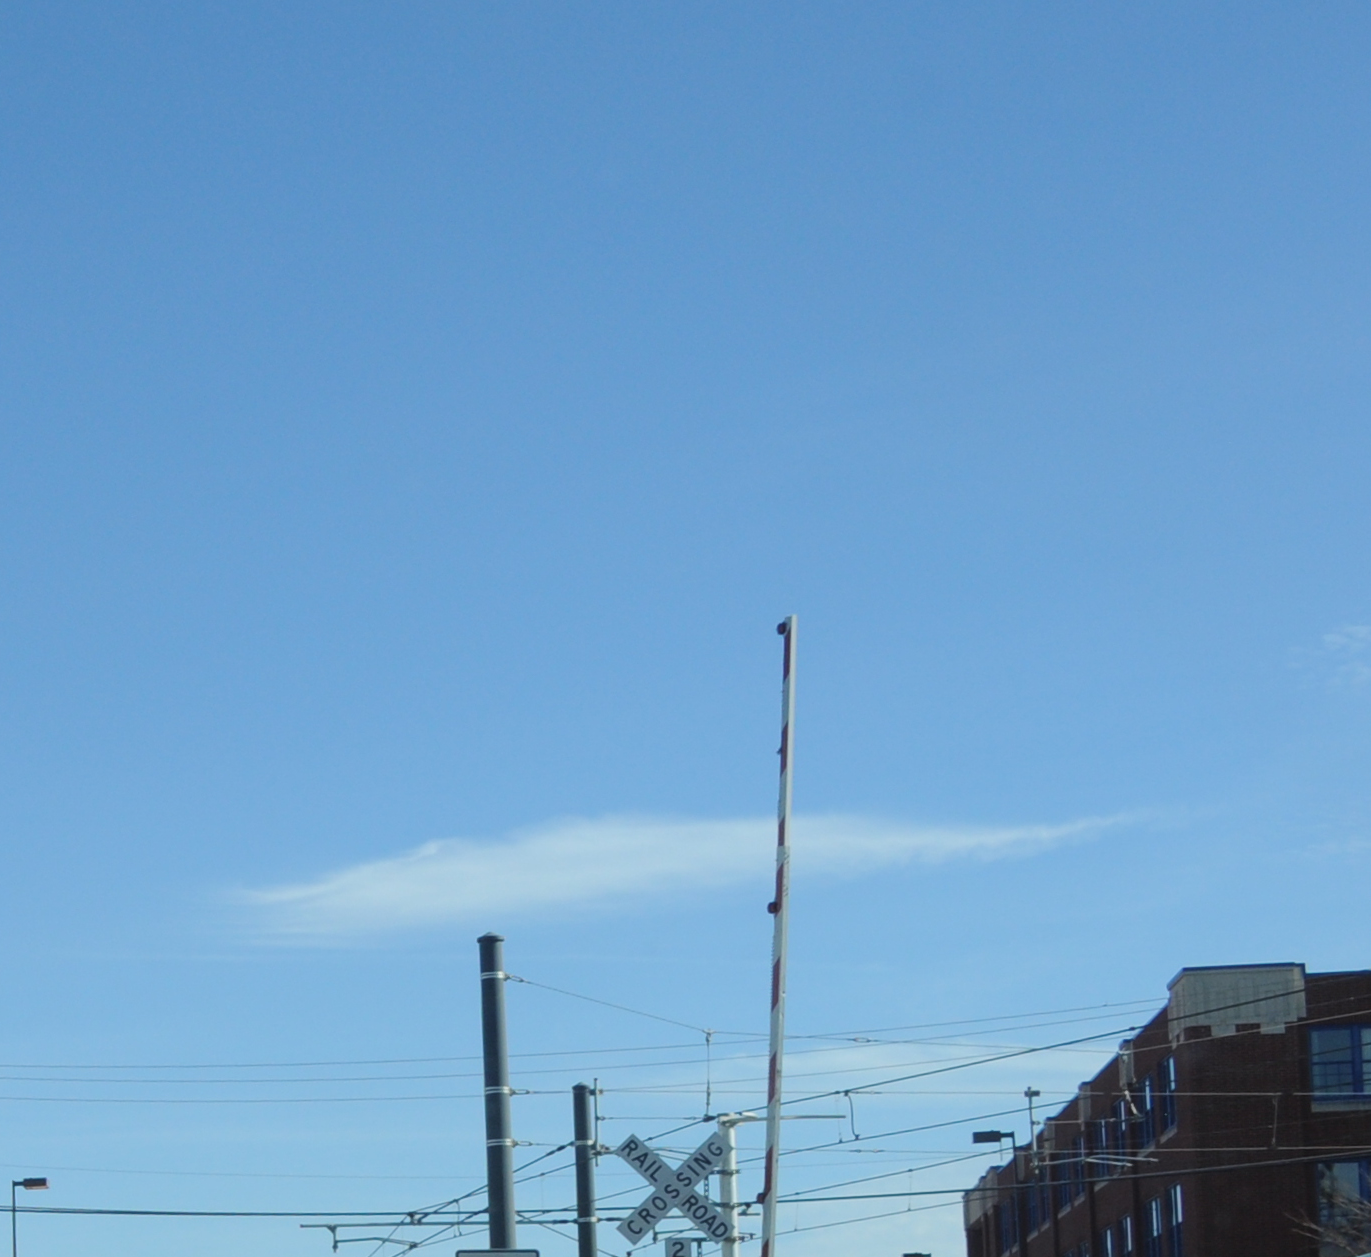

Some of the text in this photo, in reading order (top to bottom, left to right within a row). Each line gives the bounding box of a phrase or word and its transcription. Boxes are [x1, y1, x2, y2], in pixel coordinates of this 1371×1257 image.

[621, 1139, 729, 1239] RAIL ROAD
[627, 1142, 724, 1235] CROSSING
